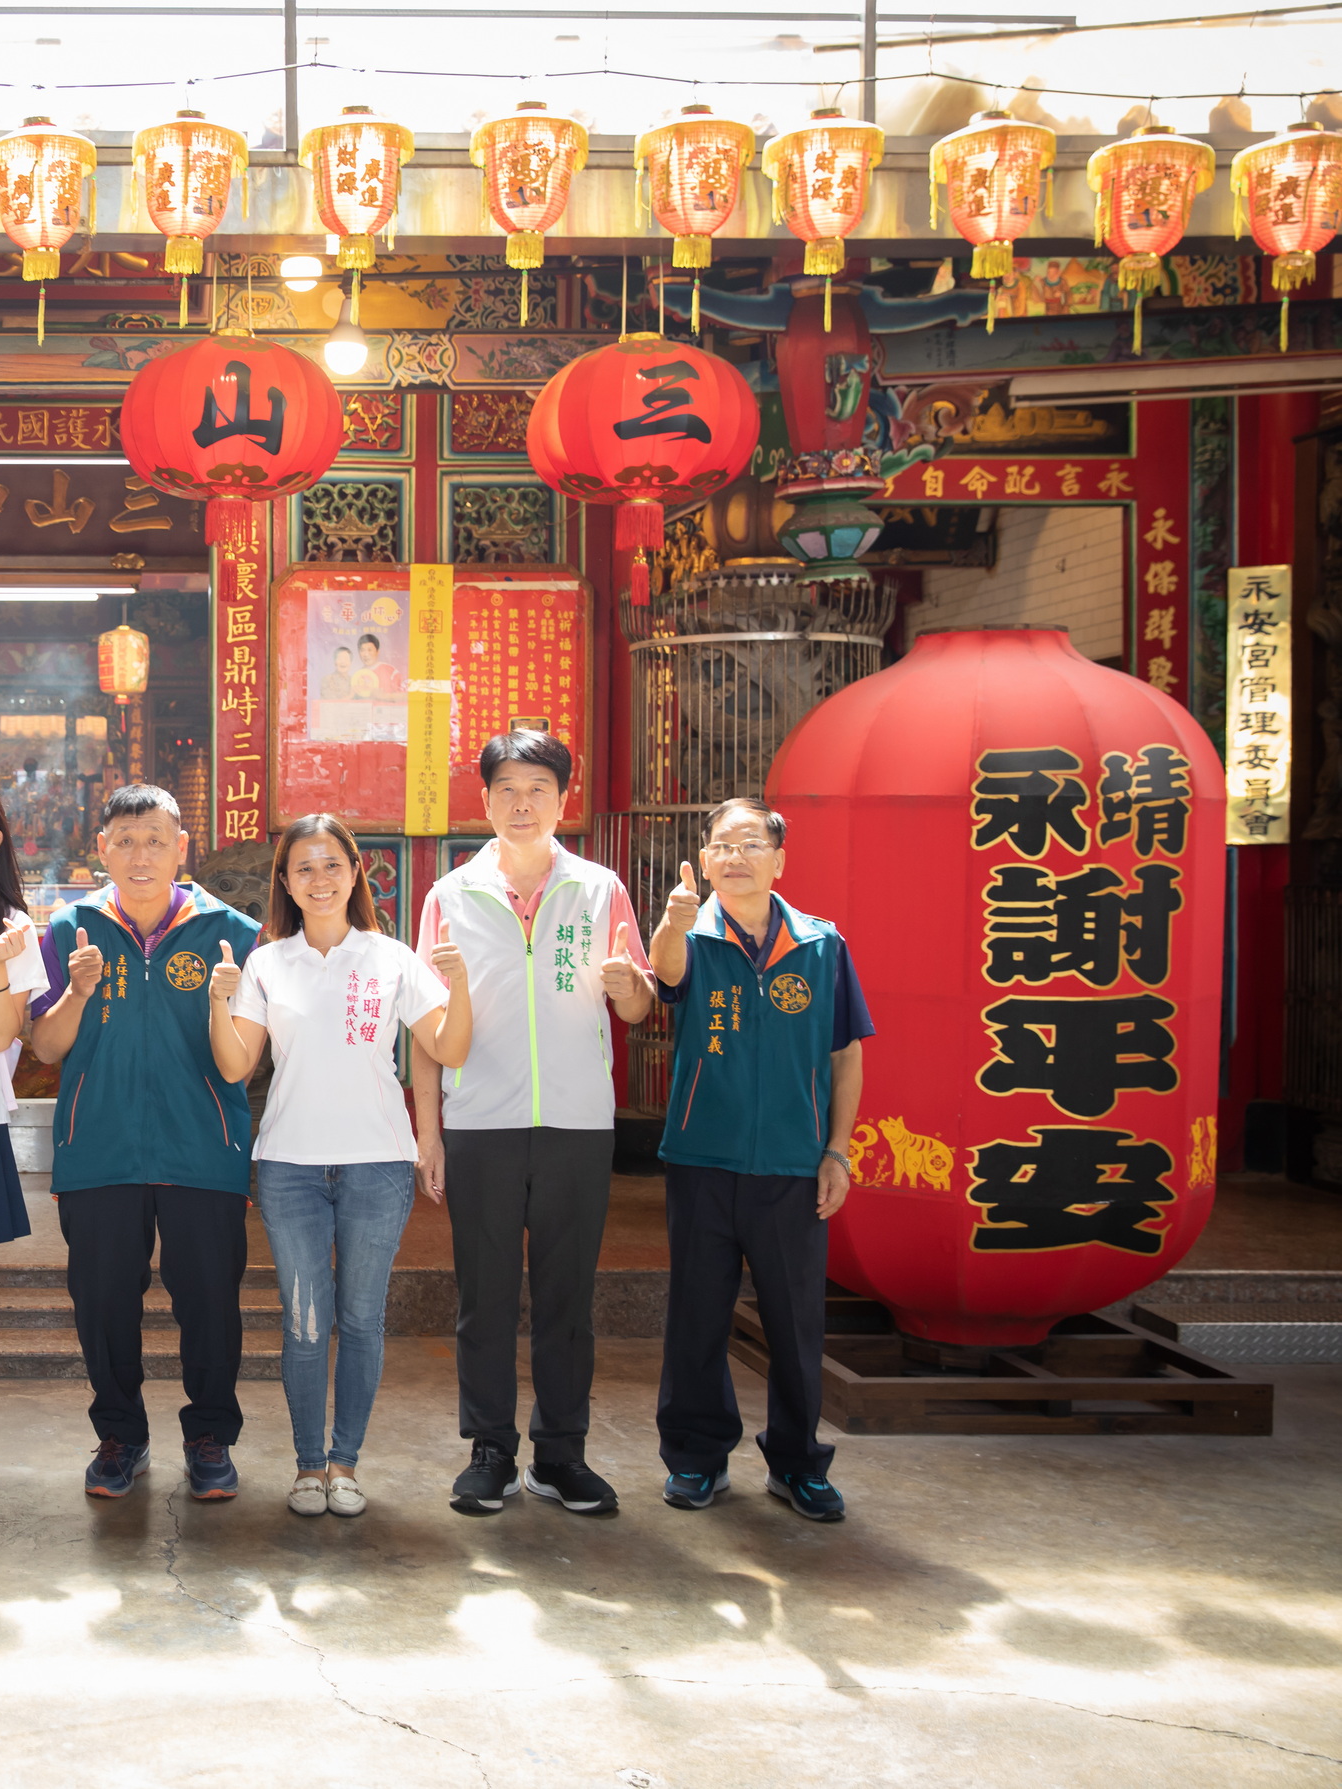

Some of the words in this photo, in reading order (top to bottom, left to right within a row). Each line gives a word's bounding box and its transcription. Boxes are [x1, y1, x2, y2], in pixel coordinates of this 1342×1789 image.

[192, 360, 287, 455] 山
[613, 360, 712, 444] 三
[1238, 575, 1282, 837] 永安宮管理委員會
[970, 744, 1193, 860] 永靖
[116, 954, 128, 999] 主任委員
[554, 924, 577, 992] 胡耿銘
[581, 910, 593, 967] 永西村長
[345, 969, 360, 1046] 永靖鄉民代表
[708, 990, 727, 1055] 張正義
[965, 861, 1184, 1256] 謝平安
